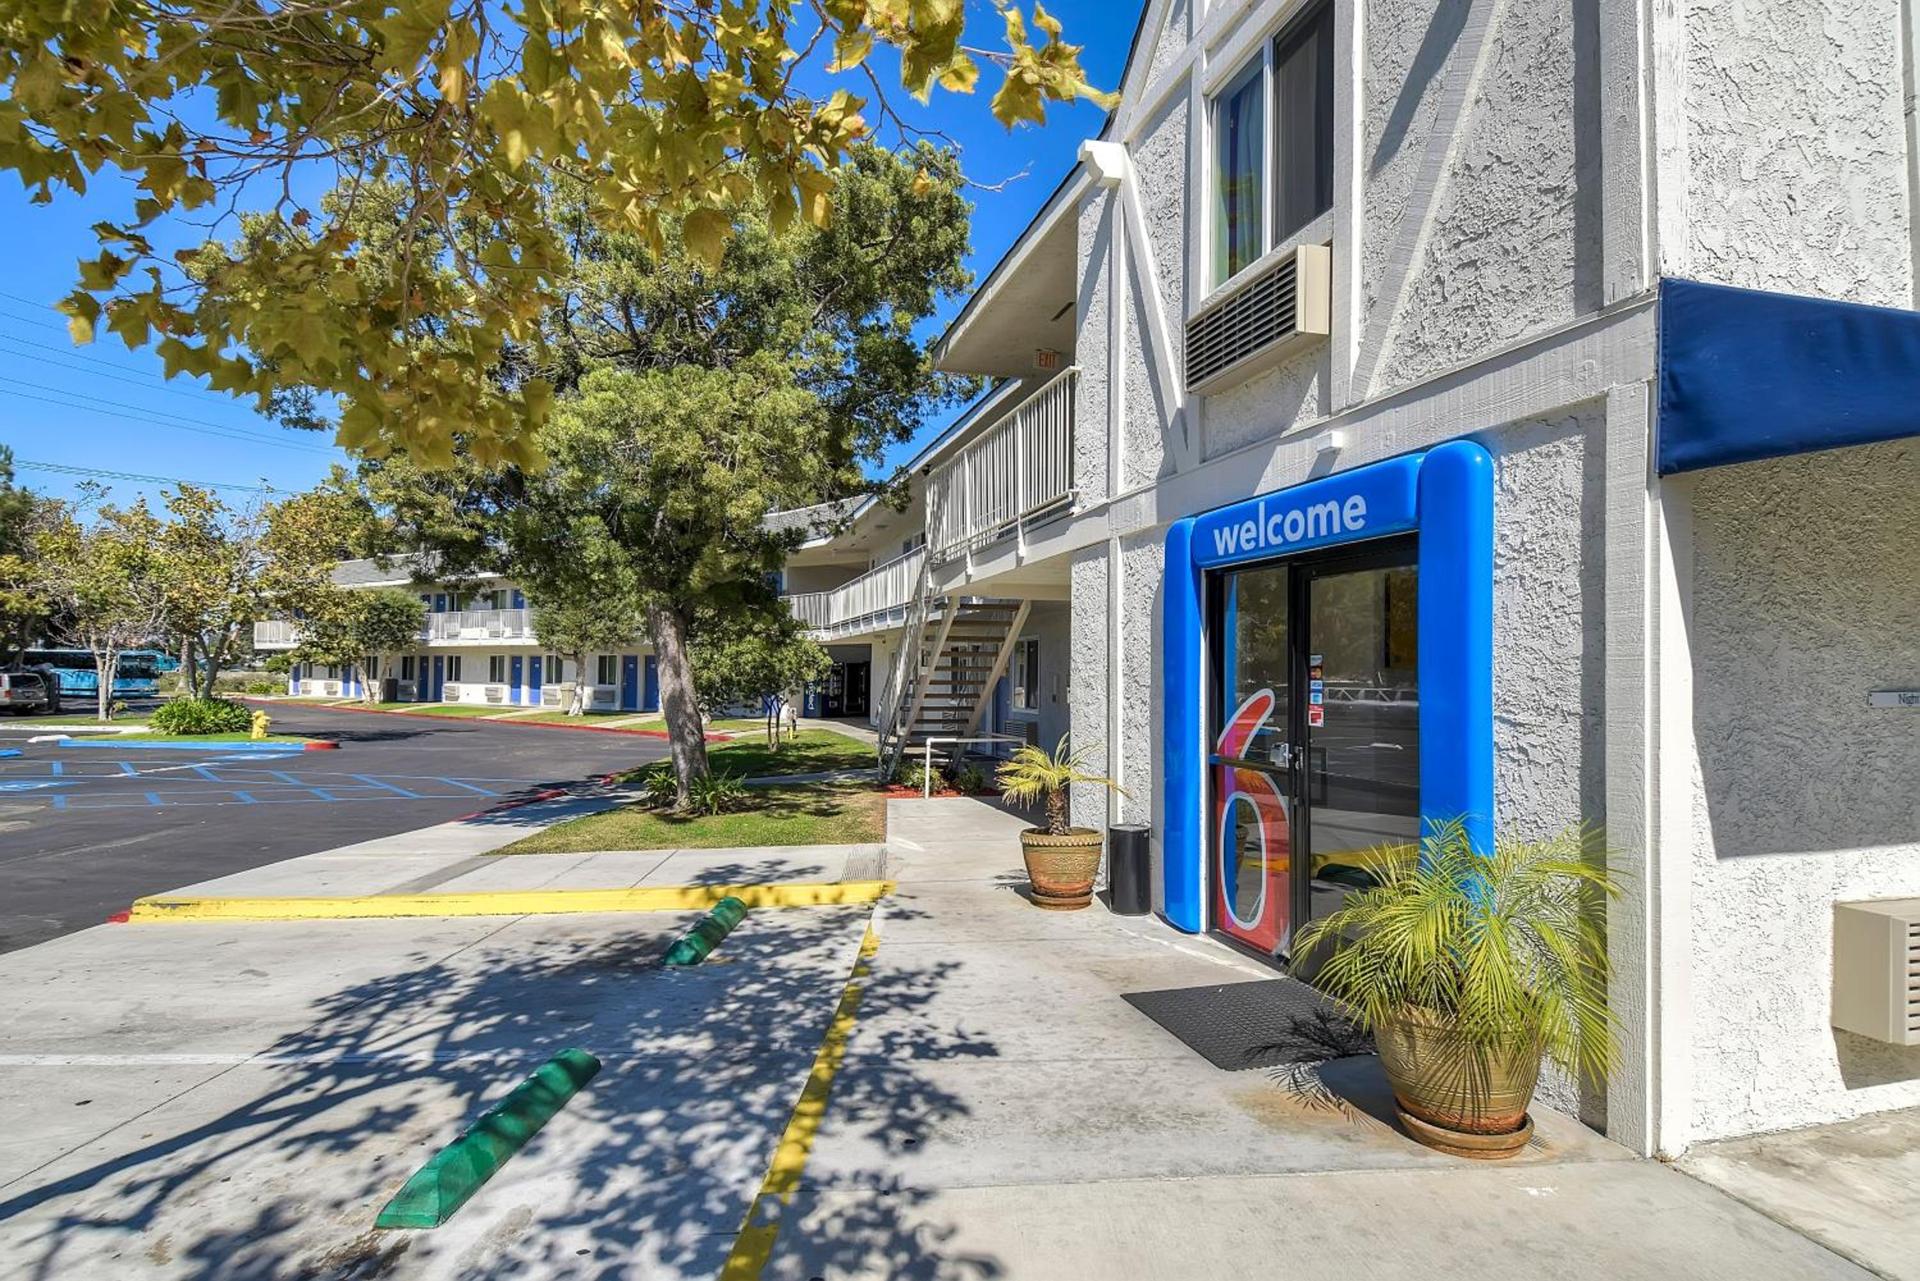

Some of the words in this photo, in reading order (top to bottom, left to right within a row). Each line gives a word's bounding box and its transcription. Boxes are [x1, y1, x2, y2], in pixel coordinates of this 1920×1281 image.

[1039, 352, 1056, 368] EXIT
[1213, 494, 1367, 556] welcome
[1216, 688, 1290, 950] 6
